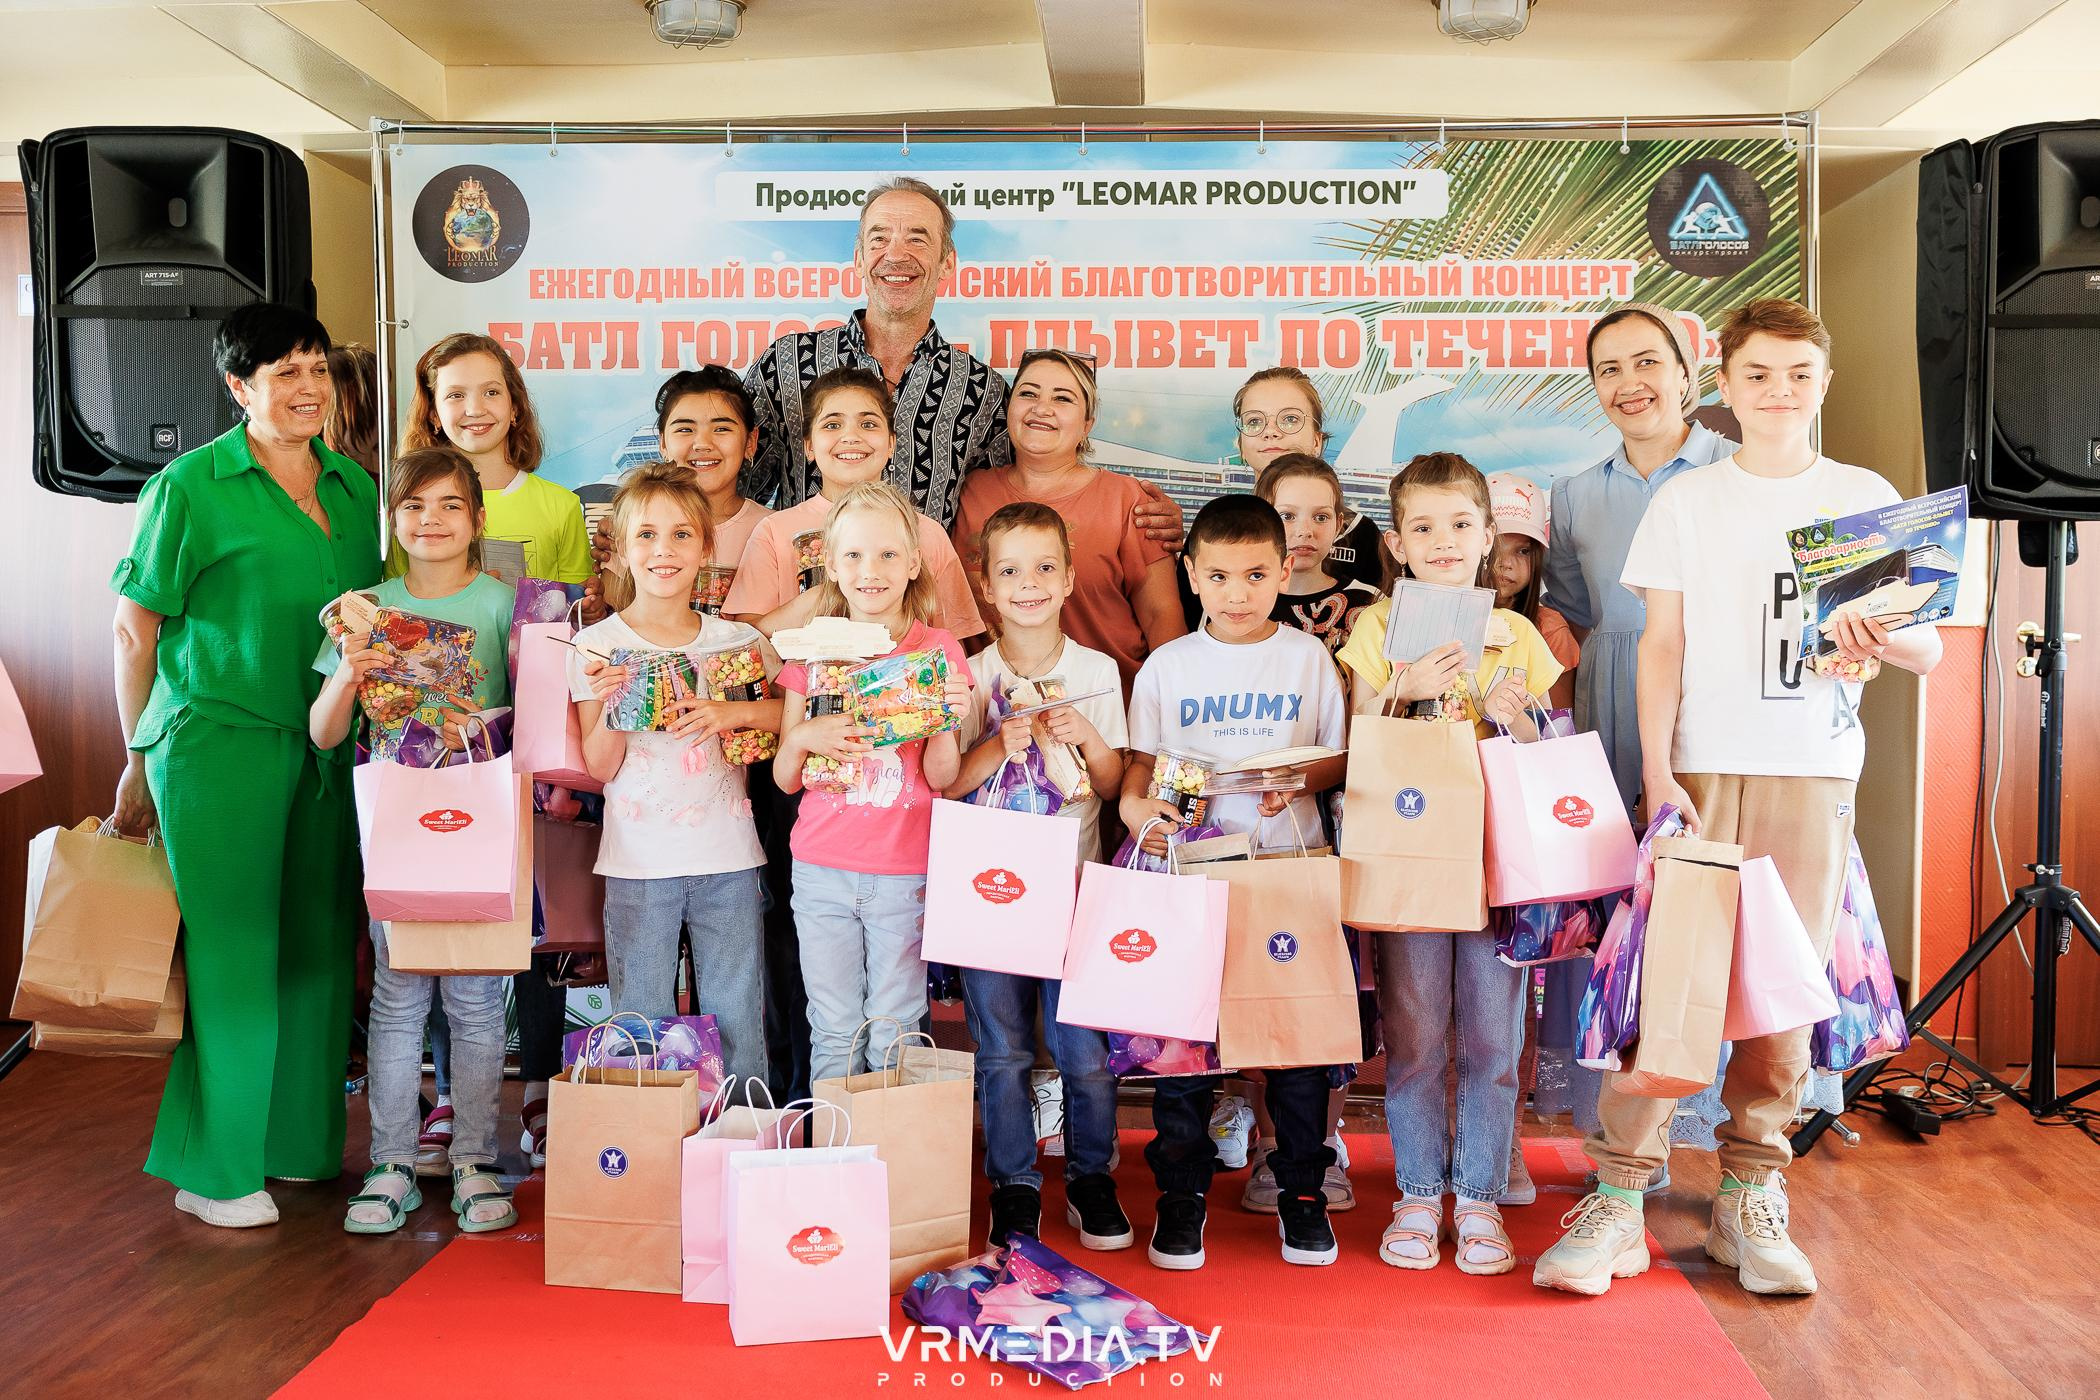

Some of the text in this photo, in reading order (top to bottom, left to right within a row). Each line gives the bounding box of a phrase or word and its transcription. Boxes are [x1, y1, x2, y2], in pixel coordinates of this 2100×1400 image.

[756, 182, 966, 211] Продюсий
[974, 188, 1055, 212] центр
[447, 245, 498, 262] LEOMAR
[529, 259, 1633, 304] ЕЖЕГОДНЫЙ ВСЕРОСКИЙ БЛАГОТВОРИТЕЛЬНЫЙ КОНЦЕРТ
[488, 321, 640, 370] БАТЛ
[989, 319, 1259, 369] ПЛЫВЕТ
[1279, 319, 1361, 369] ПО
[158, 434, 173, 442] RCF
[1796, 532, 1886, 563] Благодарность
[1180, 692, 1303, 728] DNUMX
[1213, 727, 1275, 738] THIS IS LIFE
[977, 881, 997, 891] Sweet
[792, 1245, 813, 1253] Sweet
